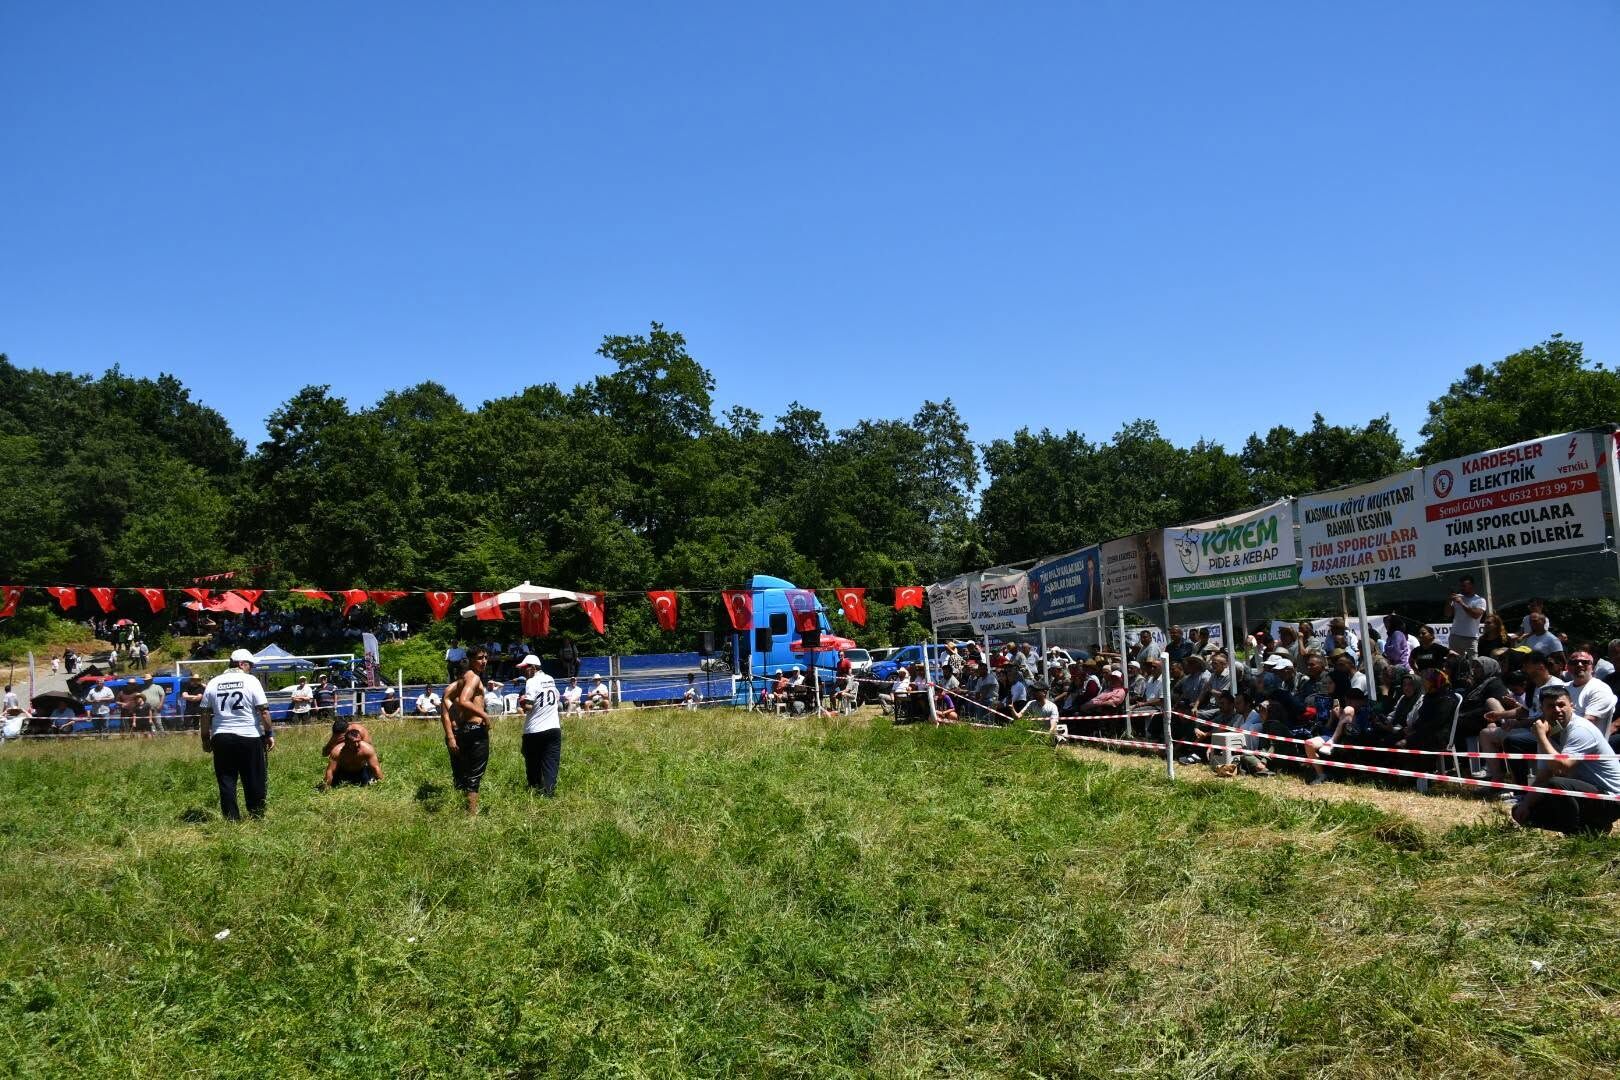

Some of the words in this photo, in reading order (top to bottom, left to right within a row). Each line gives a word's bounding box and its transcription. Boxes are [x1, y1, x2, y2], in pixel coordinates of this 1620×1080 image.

[1462, 443, 1543, 475] KARDEŞLER
[1557, 460, 1589, 474] YETKİLİ
[1469, 463, 1536, 493] ELEKTRİK
[1304, 505, 1339, 524] KASIMLI
[1340, 495, 1366, 517] KÖYÜ
[1367, 485, 1414, 511] MUHTARI
[1462, 496, 1493, 511] GÜVEN
[1509, 487, 1531, 501] 0532
[1533, 484, 1552, 498] 173
[1554, 482, 1568, 494] 99
[1570, 479, 1585, 490] 79
[1326, 518, 1356, 538] RAHMİ
[1356, 509, 1393, 533] KESKİN
[1446, 519, 1474, 537] TÜM
[1476, 502, 1575, 532] SPORCULARA
[1201, 514, 1278, 556] YÖREM
[1309, 542, 1333, 557] TÜM
[1337, 527, 1418, 552] SPORCULARA
[1444, 531, 1517, 558] BAŞARILAR
[1520, 521, 1584, 546] DİLERİZ
[1232, 555, 1241, 566] &
[1242, 547, 1279, 565] KEBAP
[1311, 553, 1374, 573] BAŞARILAR
[1378, 543, 1416, 562] DİLER
[1172, 583, 1184, 594] TÜM
[1324, 572, 1349, 587] 0535
[1352, 570, 1370, 584] 547
[1374, 569, 1385, 580] 79
[1388, 566, 1401, 579] 42
[217, 691, 244, 711] 72
[537, 690, 555, 707] 10
